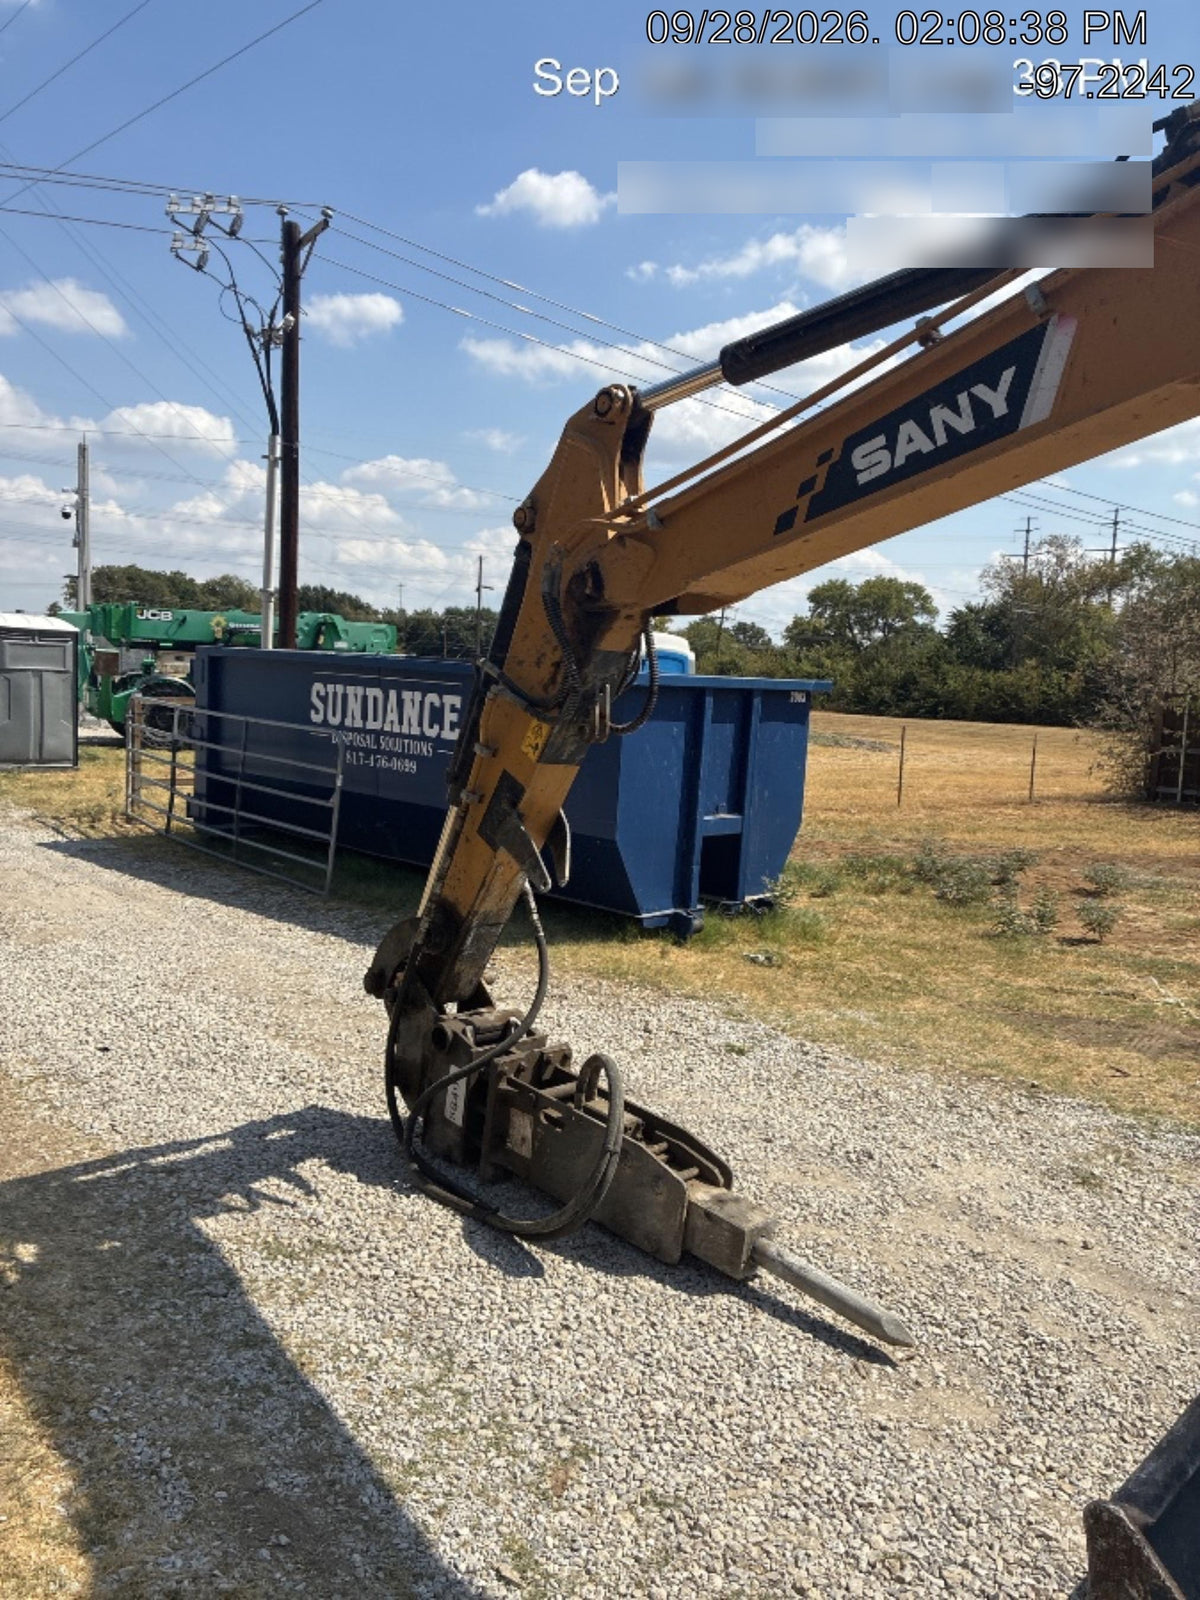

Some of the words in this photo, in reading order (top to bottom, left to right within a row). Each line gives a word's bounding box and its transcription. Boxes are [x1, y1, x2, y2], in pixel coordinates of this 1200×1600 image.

[851, 366, 1016, 486] SANY
[136, 609, 173, 622] JCB
[310, 681, 463, 741] SUNDANCE
[378, 735, 434, 757] SOLUTIONS
